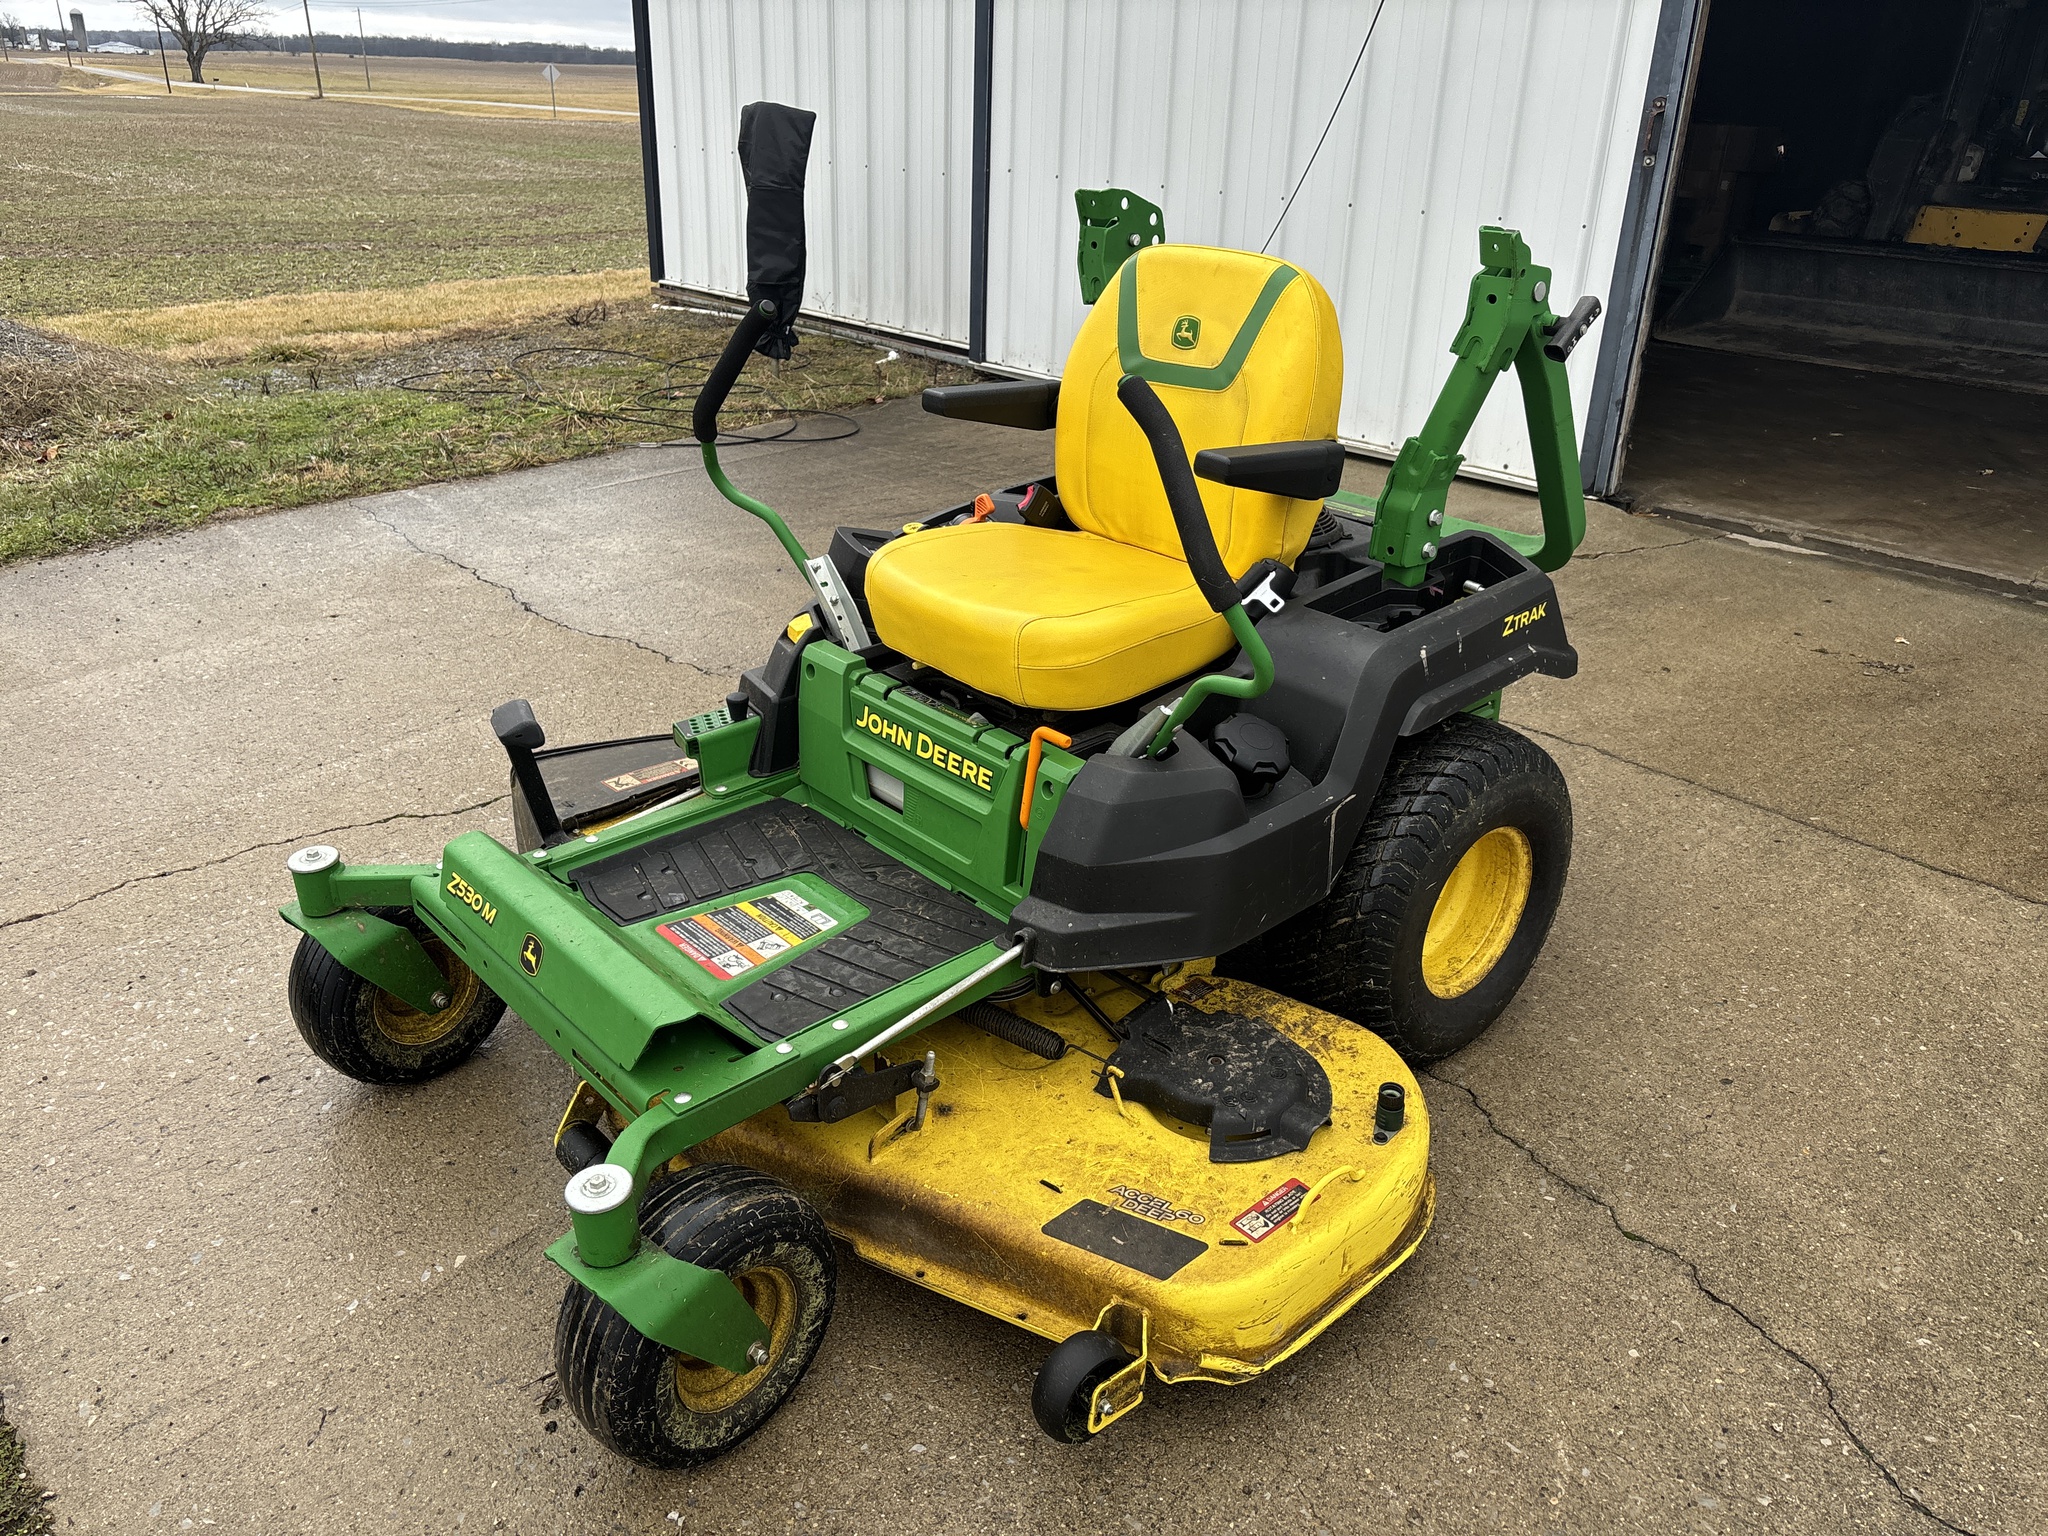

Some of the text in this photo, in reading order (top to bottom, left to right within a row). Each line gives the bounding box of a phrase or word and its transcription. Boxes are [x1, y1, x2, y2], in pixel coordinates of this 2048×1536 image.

[1502, 601, 1548, 637] ZTRAK
[856, 705, 913, 751] JOHN
[916, 731, 993, 791] DEERE
[446, 871, 498, 925] Z530 M
[679, 942, 700, 960] DANGER
[1107, 1185, 1205, 1224] ACCEL 60
[1120, 1199, 1176, 1222] DEEP
[1267, 1186, 1288, 1202] DANGER
